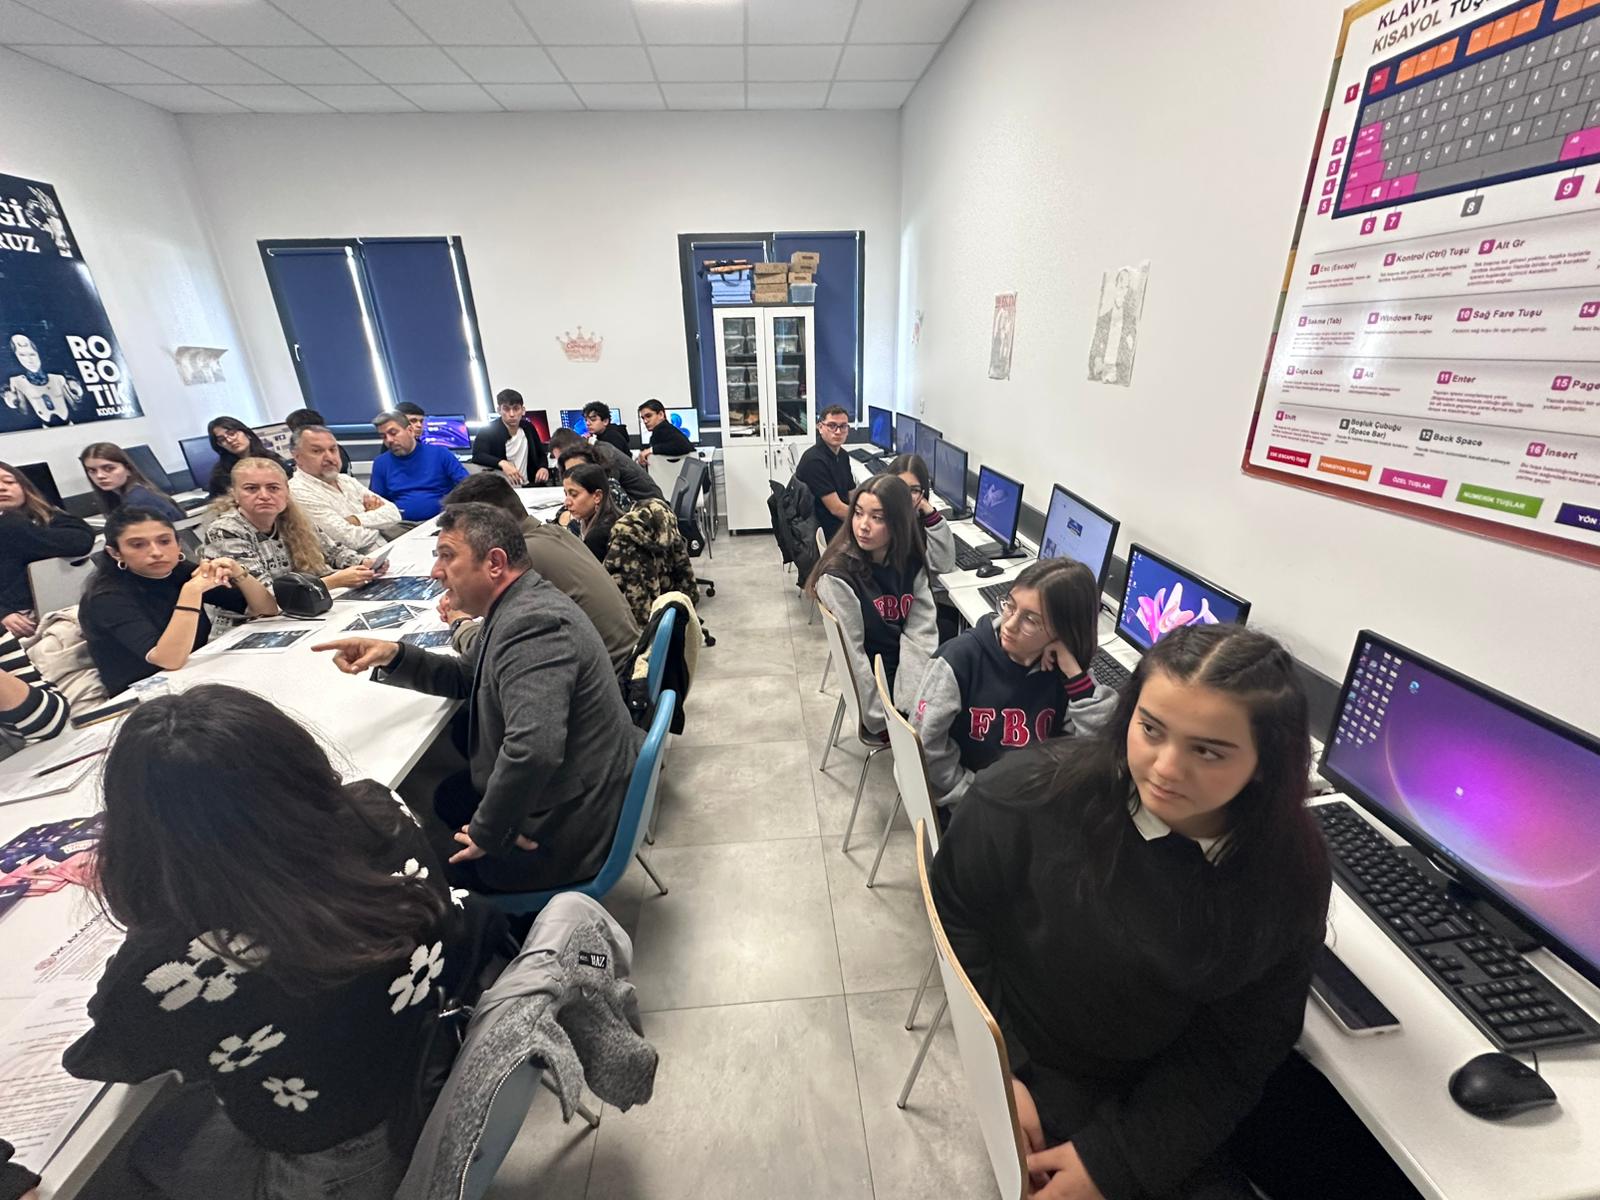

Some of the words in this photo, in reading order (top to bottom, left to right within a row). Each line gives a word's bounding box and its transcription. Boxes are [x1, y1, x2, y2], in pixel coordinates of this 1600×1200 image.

[1378, 0, 1439, 31] KLAV
[1372, 10, 1442, 54] KISAYOL
[1450, 0, 1490, 18] TUŞ
[1495, 241, 1510, 250] Alt
[1512, 239, 1526, 248] Gr
[1396, 252, 1425, 262] Kontrol
[1426, 249, 1447, 260] (Ctrl)
[1449, 247, 1470, 257] Tuşu
[1414, 313, 1432, 322] Tuşu
[1473, 310, 1491, 320] Sağ
[1493, 309, 1515, 318] Fare
[1518, 308, 1543, 318] Tuşu
[66, 335, 112, 359] RO
[76, 360, 121, 384] BO
[1309, 368, 1323, 376] Lock
[1452, 374, 1476, 384] Enter
[1572, 379, 1600, 391] Page
[1433, 433, 1454, 443] Back
[1455, 436, 1483, 447] Space
[1408, 478, 1432, 490] TUŞLAR
[1578, 514, 1598, 525] YÖN
